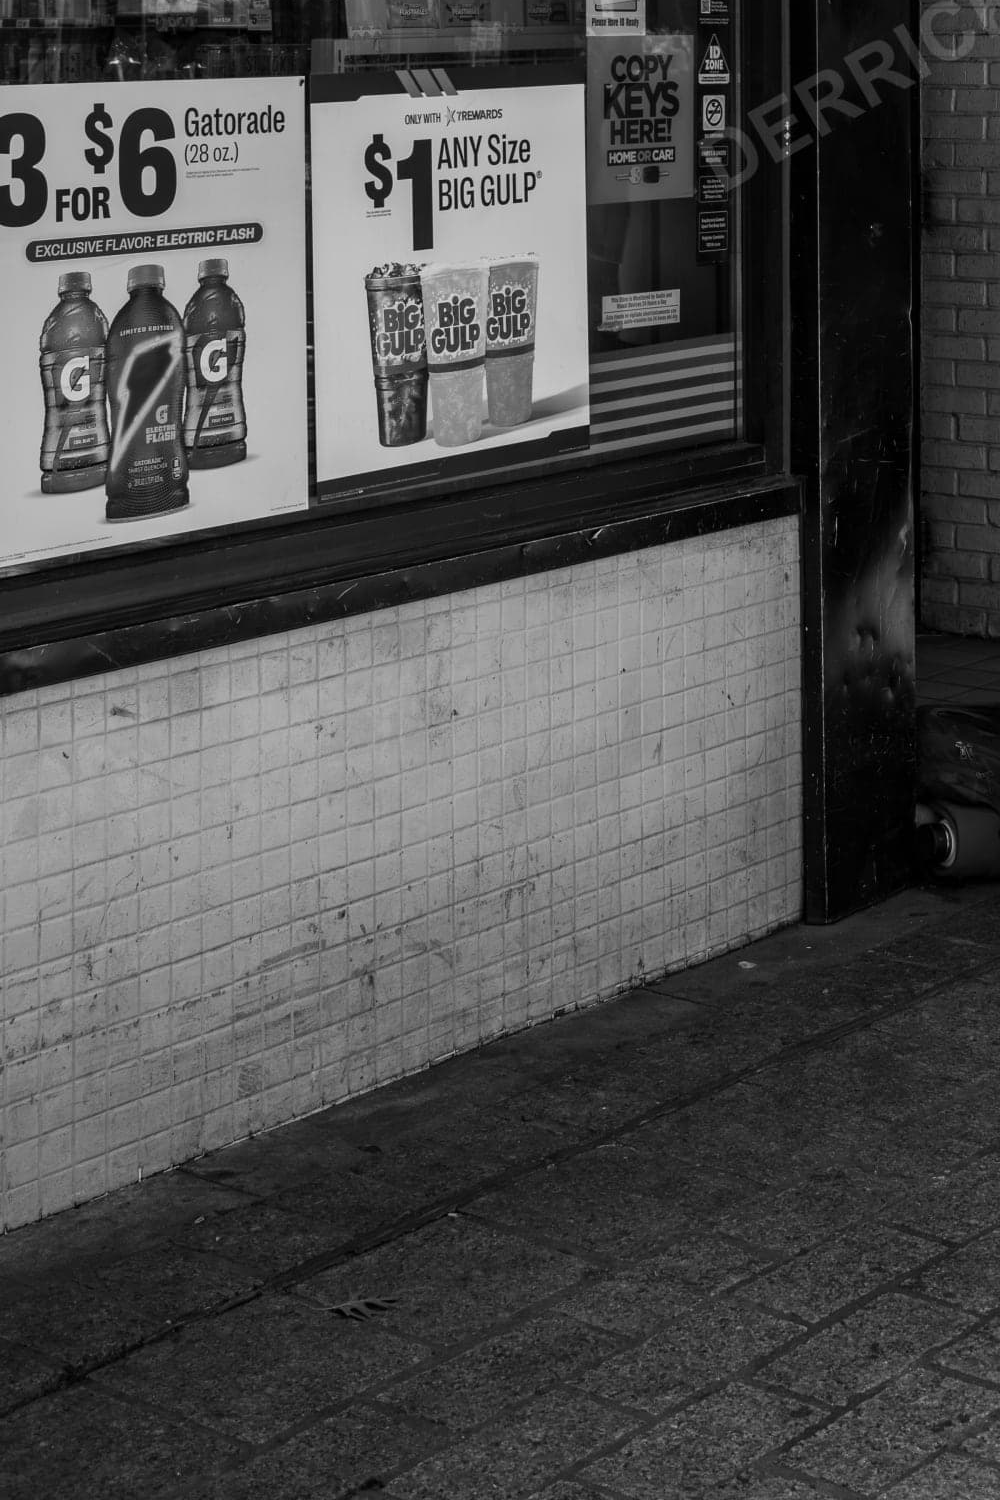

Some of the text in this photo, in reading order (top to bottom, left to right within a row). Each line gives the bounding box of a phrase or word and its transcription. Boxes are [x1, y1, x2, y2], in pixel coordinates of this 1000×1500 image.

[704, 59, 724, 71] ZONE
[709, 45, 721, 59] ID
[610, 54, 674, 82] COPY
[604, 81, 681, 120] KEYS
[184, 105, 286, 138] Gatorade
[405, 108, 504, 125] ONLY WITH 7REWARDS
[610, 118, 672, 146] HERE!
[0, 102, 178, 228] 3 FOR $6
[184, 141, 239, 167] (28 oz.)
[437, 134, 531, 170] ANY Size
[608, 148, 675, 164] HOME OR CAR!
[364, 133, 434, 251] $1
[438, 176, 475, 211] BIG
[35, 227, 255, 258] EXCLUSIVE FLAVOR: ELECTRIC FLASH
[120, 326, 147, 337] LIMITED
[377, 327, 426, 357] GULP
[432, 323, 481, 354] GULP
[486, 313, 531, 342] GULP
[200, 338, 228, 383] G
[60, 355, 91, 402] G
[155, 404, 168, 425] G
[146, 430, 176, 444] FLASH
